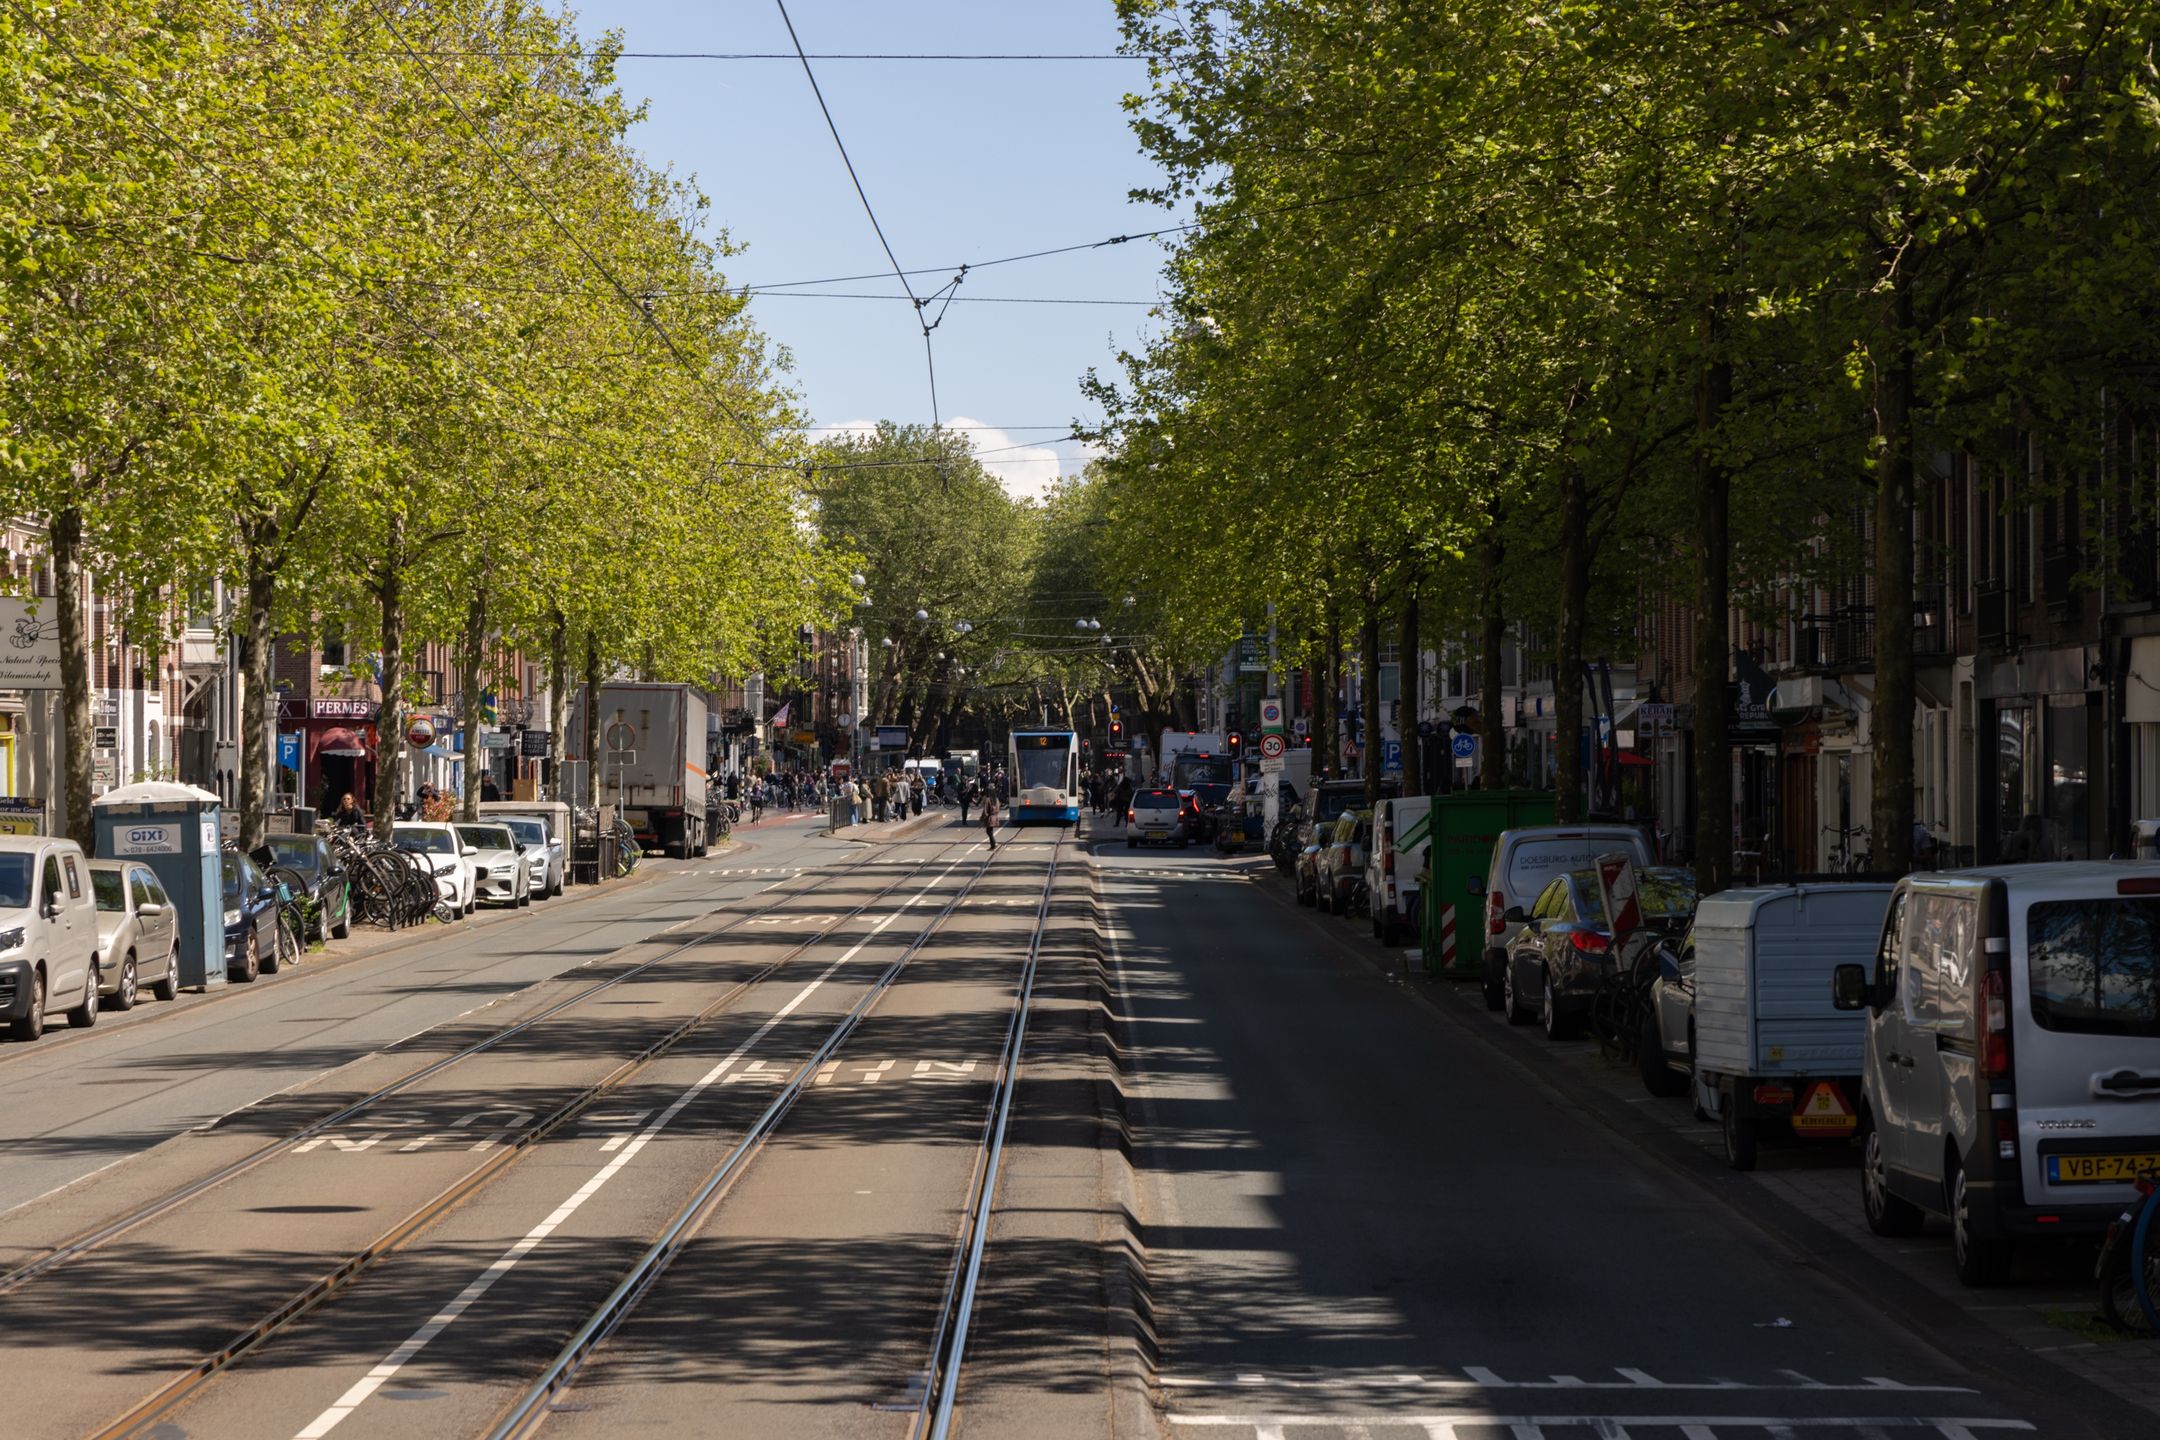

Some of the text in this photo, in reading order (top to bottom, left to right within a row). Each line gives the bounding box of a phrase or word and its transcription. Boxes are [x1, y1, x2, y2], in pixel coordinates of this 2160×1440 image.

[316, 701, 368, 714] HERMES
[1739, 711, 1769, 720] REPUBL
[1039, 736, 1048, 746] 12
[1265, 741, 1281, 751] 30
[284, 745, 294, 760] P
[1389, 744, 1400, 759] P
[1520, 855, 1566, 865] DOESBURG
